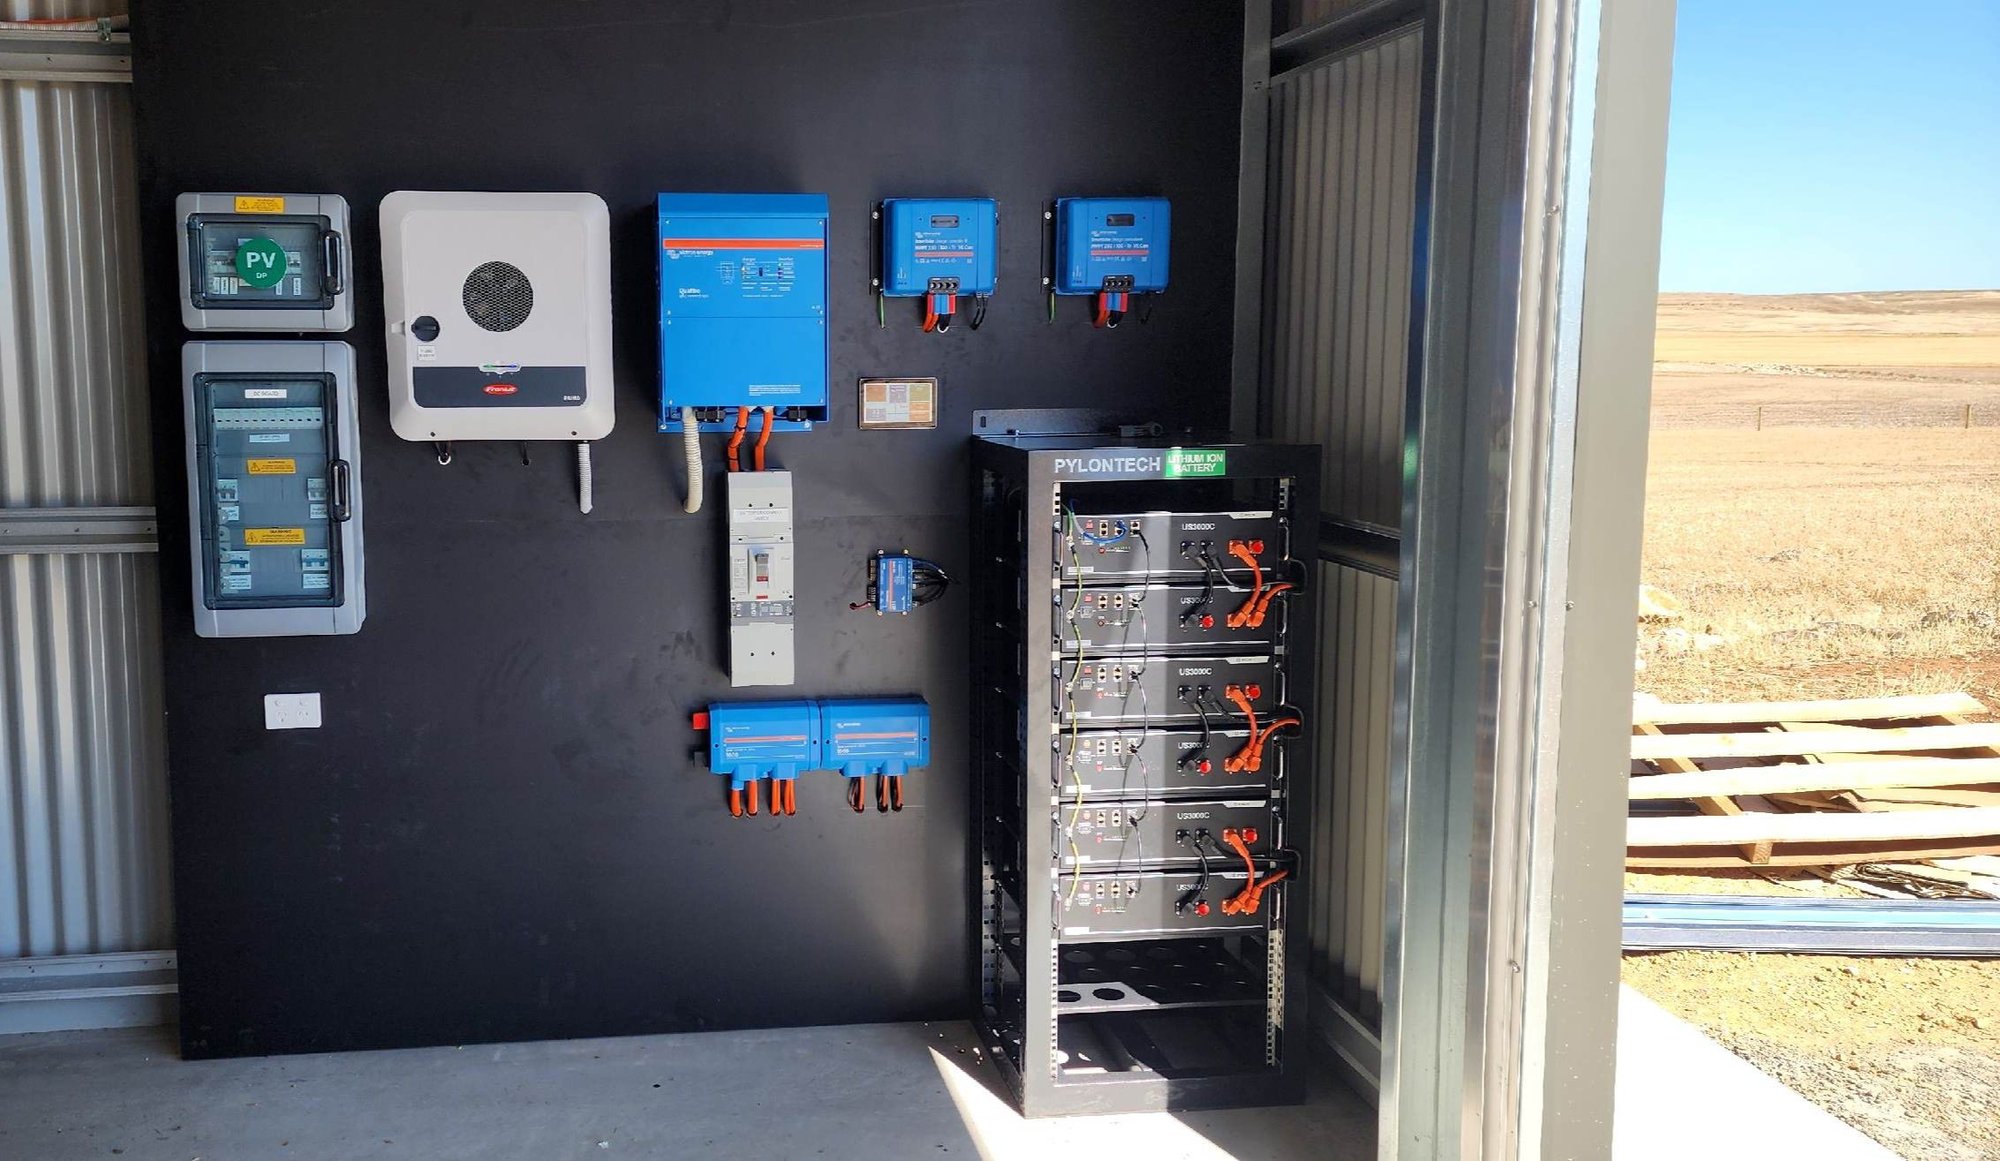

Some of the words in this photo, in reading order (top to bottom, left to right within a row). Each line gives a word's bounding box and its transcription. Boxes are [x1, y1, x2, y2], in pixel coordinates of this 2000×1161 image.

[246, 252, 276, 268] PV
[1168, 454, 1204, 463] LITHIUM
[1207, 453, 1223, 462] ION
[1054, 457, 1160, 473] PYLONTECH
[1175, 463, 1216, 472] BATTERY
[1182, 523, 1216, 531] US3000C
[1179, 668, 1213, 676] US3000C
[1177, 812, 1210, 820] US3000C
